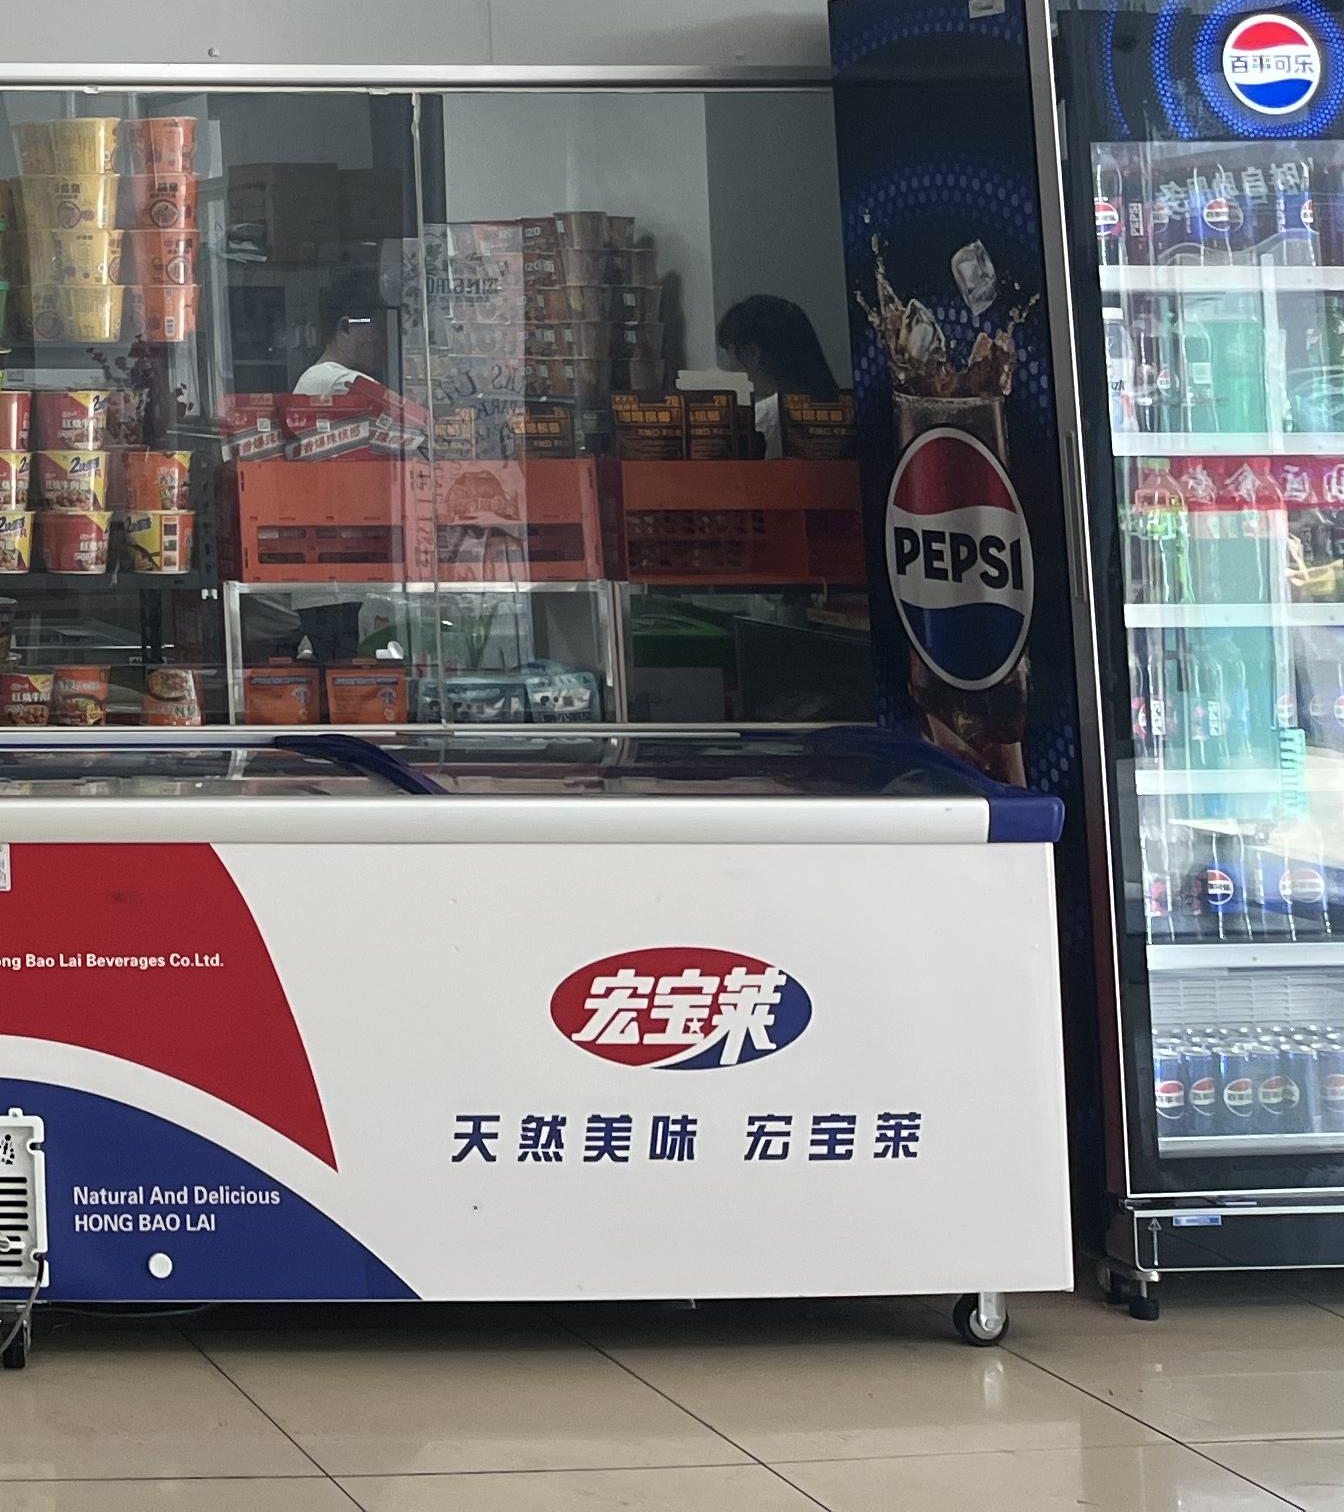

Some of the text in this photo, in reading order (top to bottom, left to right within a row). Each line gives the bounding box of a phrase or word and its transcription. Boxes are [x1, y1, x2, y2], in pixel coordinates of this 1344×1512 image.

[1230, 53, 1315, 74] 百事可乐
[893, 526, 1024, 591] PEPSI
[26, 953, 55, 968] Bao
[59, 953, 82, 968] Lai
[86, 953, 165, 970] Beverages
[169, 953, 224, 968] Co.Ltd.
[571, 966, 787, 1065] 宏宝莱
[451, 1111, 923, 1163] 天然美味 宏宝莱
[73, 1185, 281, 1206] Natural And Delicious
[74, 1212, 217, 1232] HONG BAO LAI
